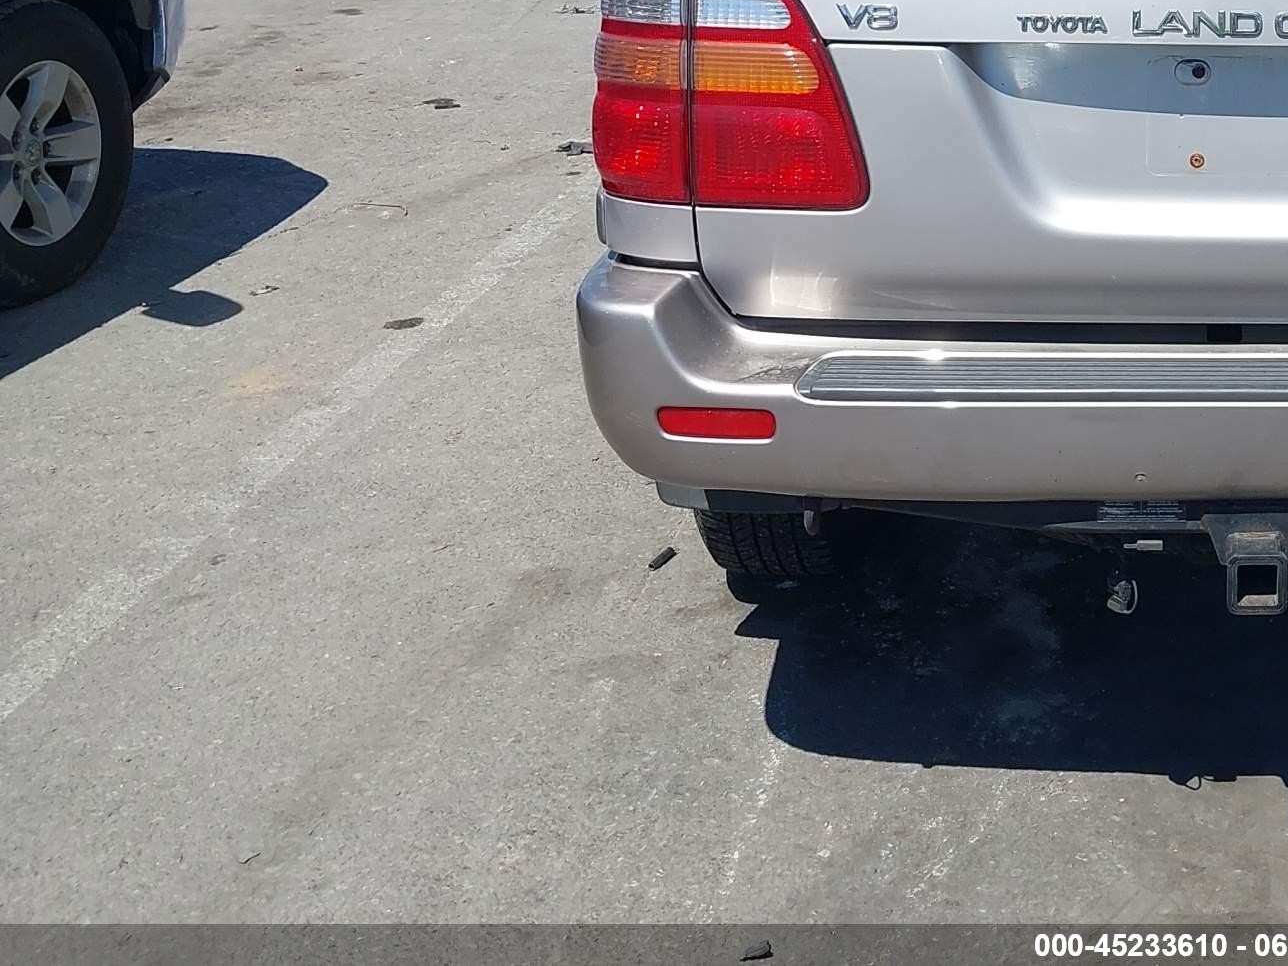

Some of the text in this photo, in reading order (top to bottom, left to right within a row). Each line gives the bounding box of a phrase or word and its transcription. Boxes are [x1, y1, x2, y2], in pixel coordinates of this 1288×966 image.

[836, 3, 898, 30] V8
[1016, 15, 1108, 34] TOYOTA
[1132, 9, 1263, 38] LAND
